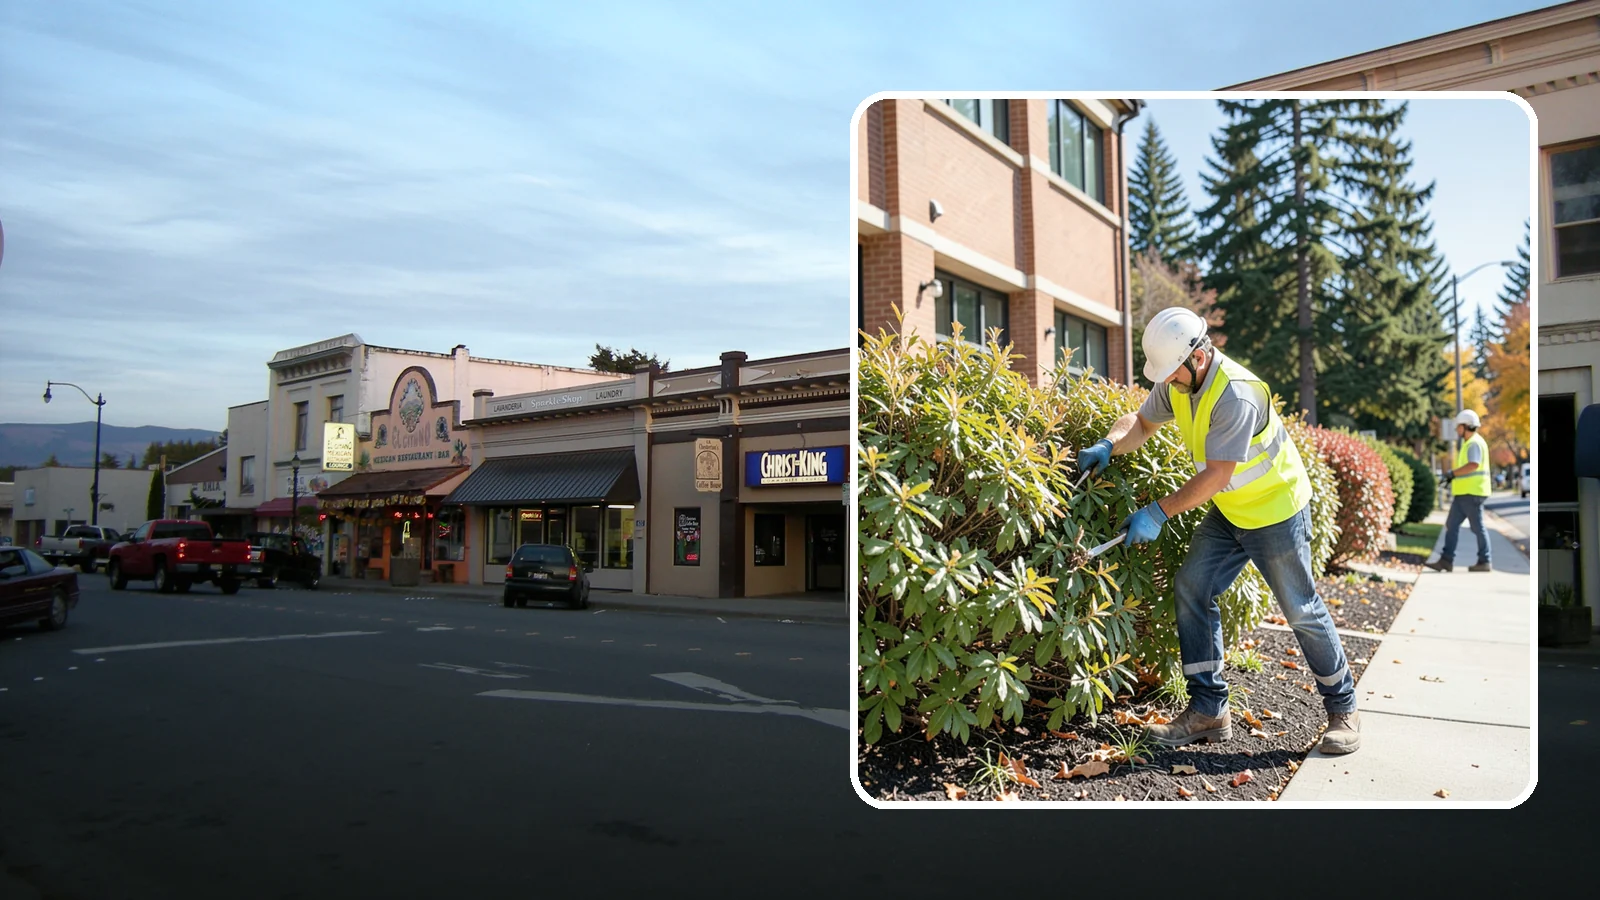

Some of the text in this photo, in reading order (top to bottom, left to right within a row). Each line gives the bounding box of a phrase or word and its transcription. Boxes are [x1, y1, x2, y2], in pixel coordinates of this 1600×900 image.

[596, 389, 623, 399] LAUNDRY
[494, 402, 522, 412] LAVANDERIA
[531, 395, 582, 408] Sparkle Shop
[374, 455, 396, 464] MEXICAN
[398, 452, 433, 461] RESTAURANT
[761, 450, 827, 478] CHRIST KING
